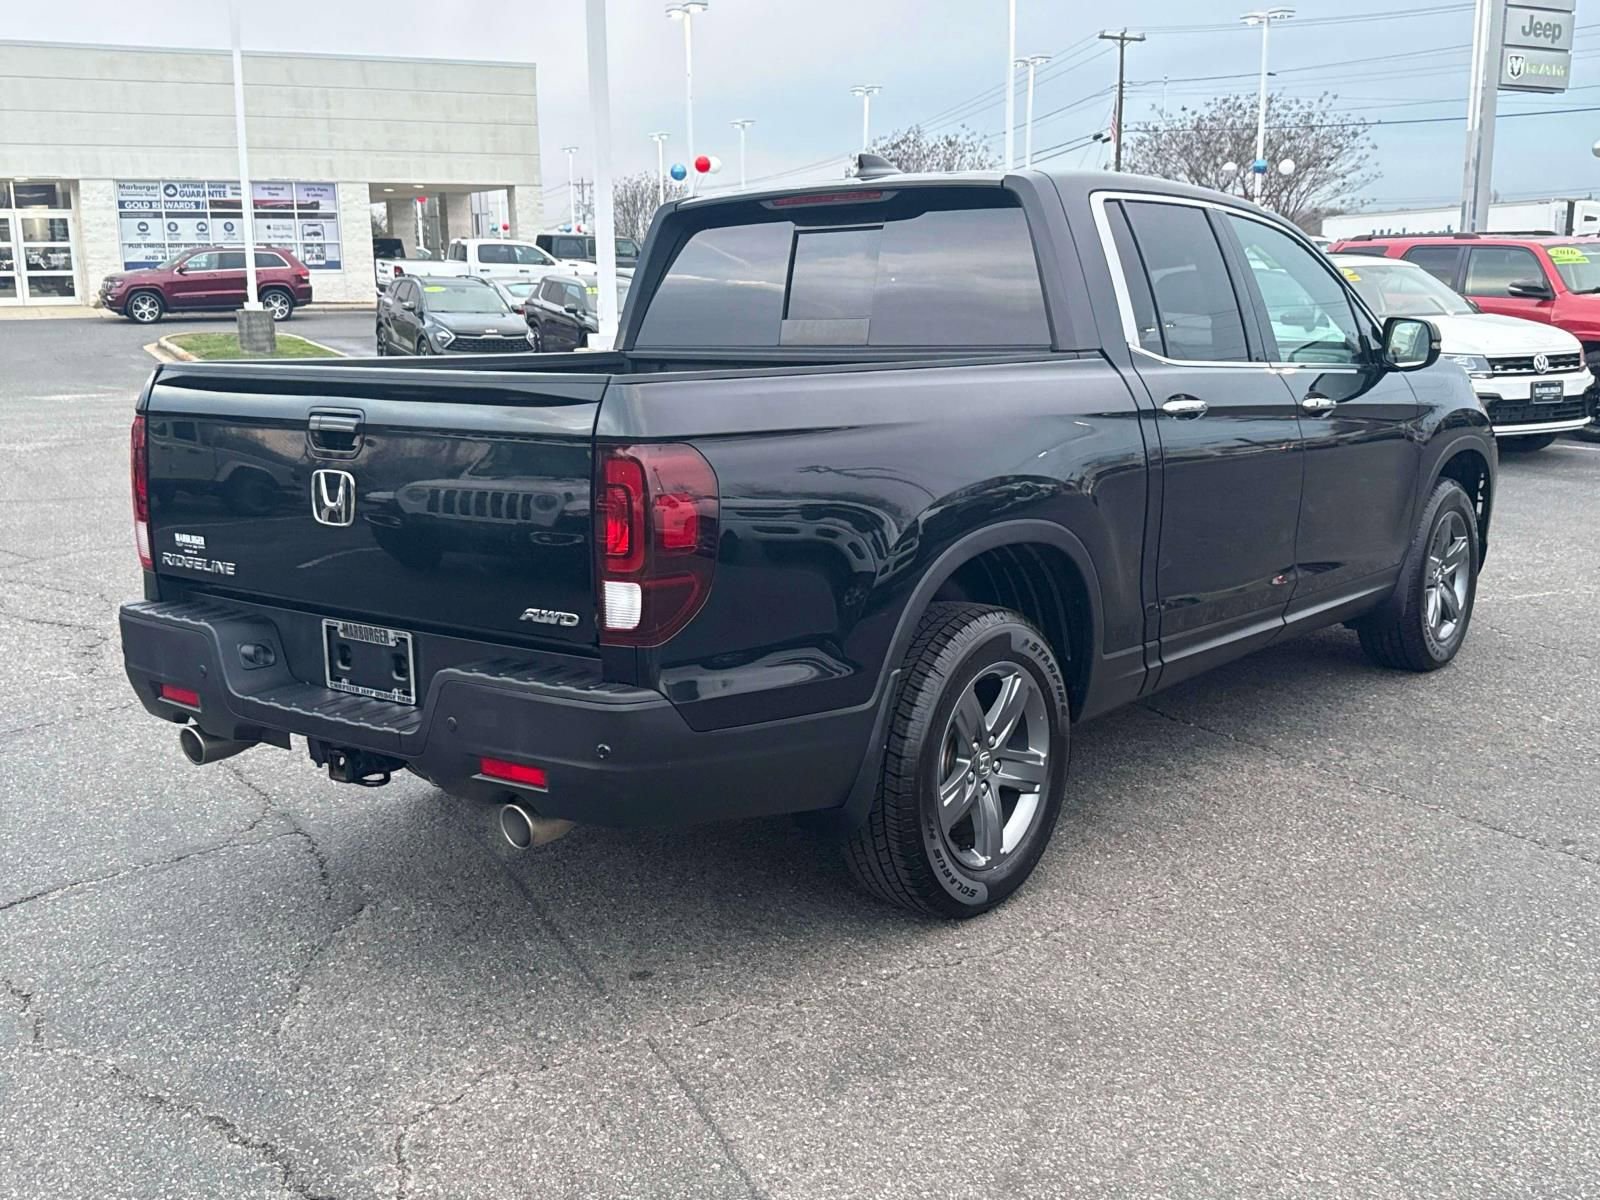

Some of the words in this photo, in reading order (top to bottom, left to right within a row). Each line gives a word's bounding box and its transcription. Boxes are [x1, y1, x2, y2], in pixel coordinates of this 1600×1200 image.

[1521, 14, 1562, 44] Jeep
[118, 183, 158, 192] Marburger
[179, 190, 227, 198] GUARANTEE
[124, 201, 150, 209] GOLD
[162, 551, 236, 576] RIDGELINE
[519, 607, 580, 627] AWD
[342, 622, 390, 645] MARBURGER
[1029, 642, 1068, 717] STARFIRE
[933, 848, 978, 898] SOLARUS
